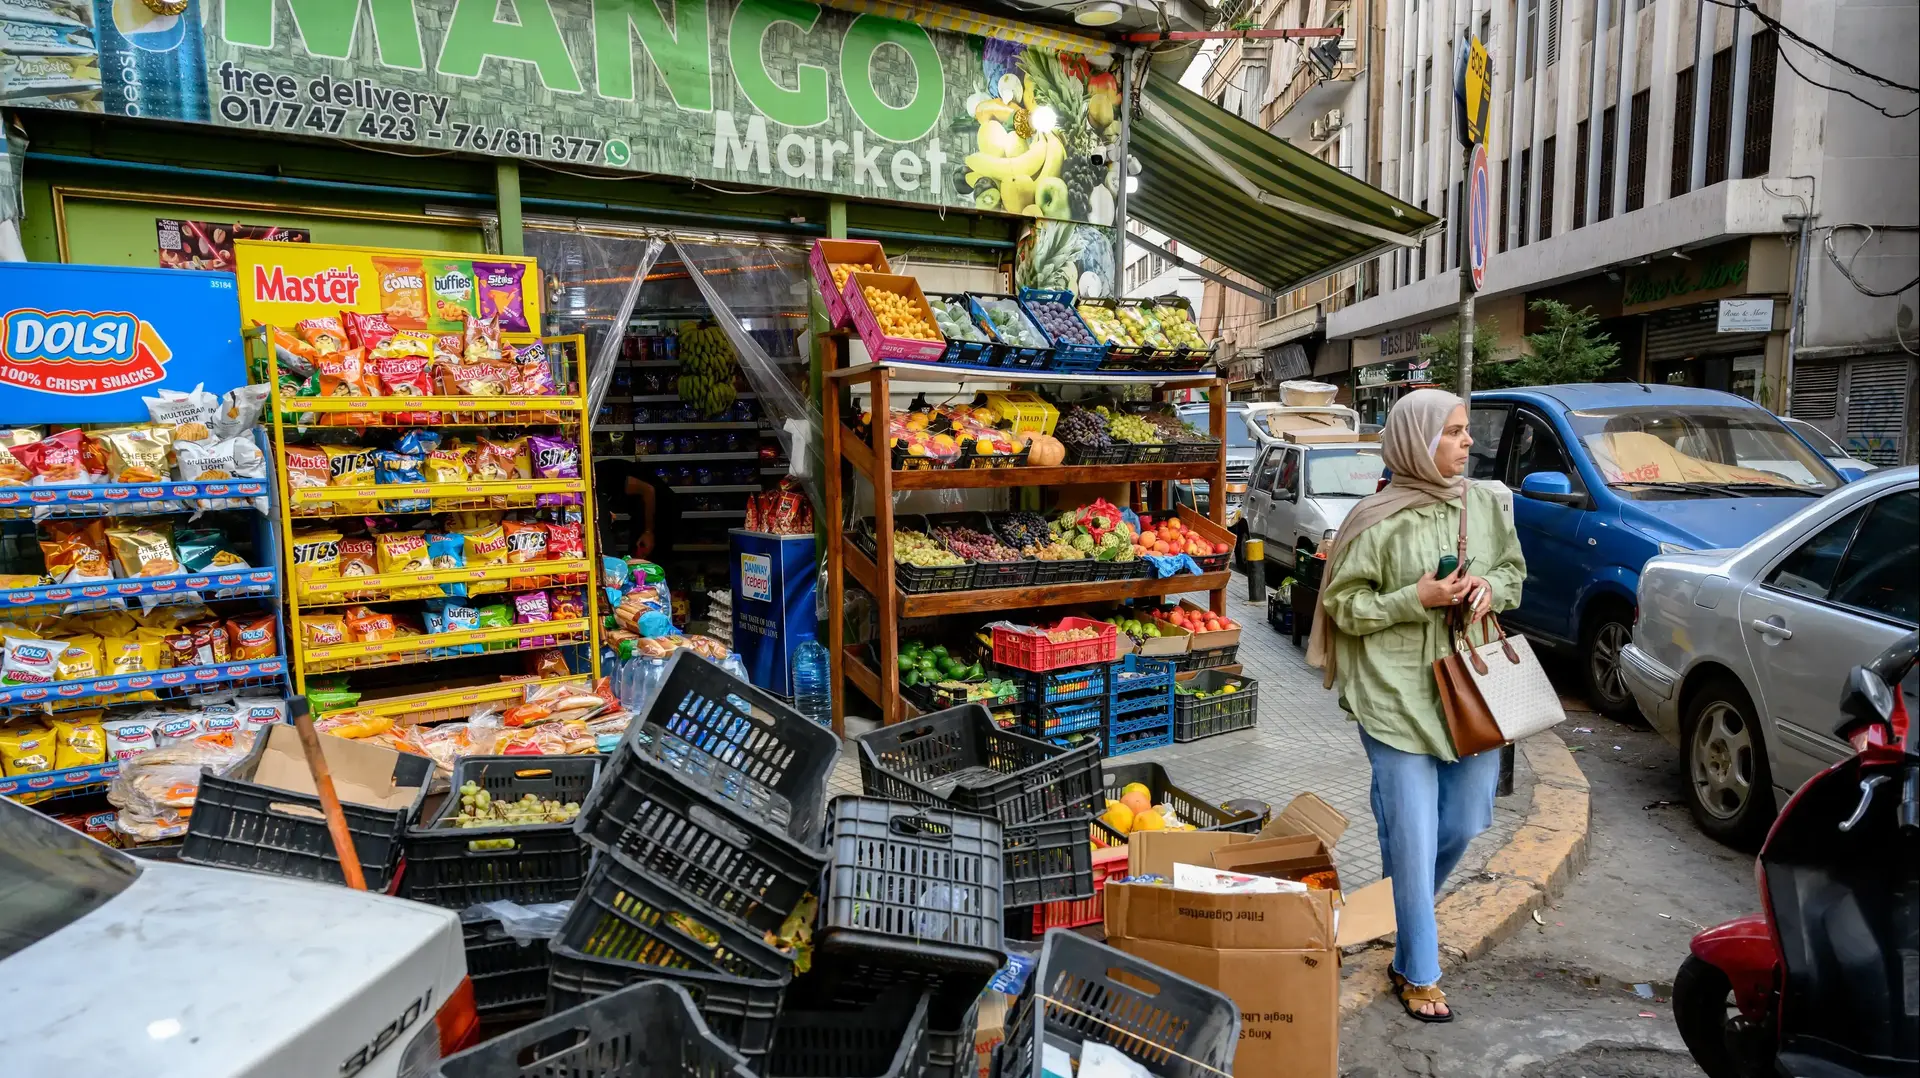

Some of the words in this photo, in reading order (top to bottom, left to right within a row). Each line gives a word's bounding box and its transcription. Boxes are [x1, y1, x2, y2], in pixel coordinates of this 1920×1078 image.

[16, 59, 74, 76] Majestic
[219, 61, 297, 99] free
[308, 74, 449, 125] delivery
[357, 112, 416, 141] 423
[452, 122, 544, 157] 76/811
[551, 136, 601, 163] 377
[713, 111, 947, 195] Market
[326, 264, 360, 282] ماستر
[211, 281, 231, 289] 35184
[254, 264, 360, 305] Master
[382, 274, 424, 293] CONES
[433, 275, 471, 291] buffies
[15, 319, 129, 355] DOLSI
[1387, 335, 1405, 356] BSL
[0, 364, 42, 387] 100%
[45, 375, 98, 392] CRISPY
[102, 366, 156, 389] SNACKS
[175, 415, 200, 425] LIGHT
[331, 452, 375, 477] SITOS
[293, 541, 339, 565] SITOS
[242, 630, 264, 640] DOLSI
[19, 647, 46, 658] DOLSI
[252, 708, 275, 717] DOLSI
[166, 721, 189, 732] DOLSI
[210, 718, 233, 726] DOLSI
[120, 726, 145, 735] DOLSI
[91, 814, 114, 826] DOLSI
[1178, 907, 1234, 922] Cigarettes
[1236, 910, 1265, 922] Filter
[1240, 1012, 1261, 1023] Liba
[1264, 1012, 1294, 1024] Regie
[1248, 1029, 1272, 1040] King
